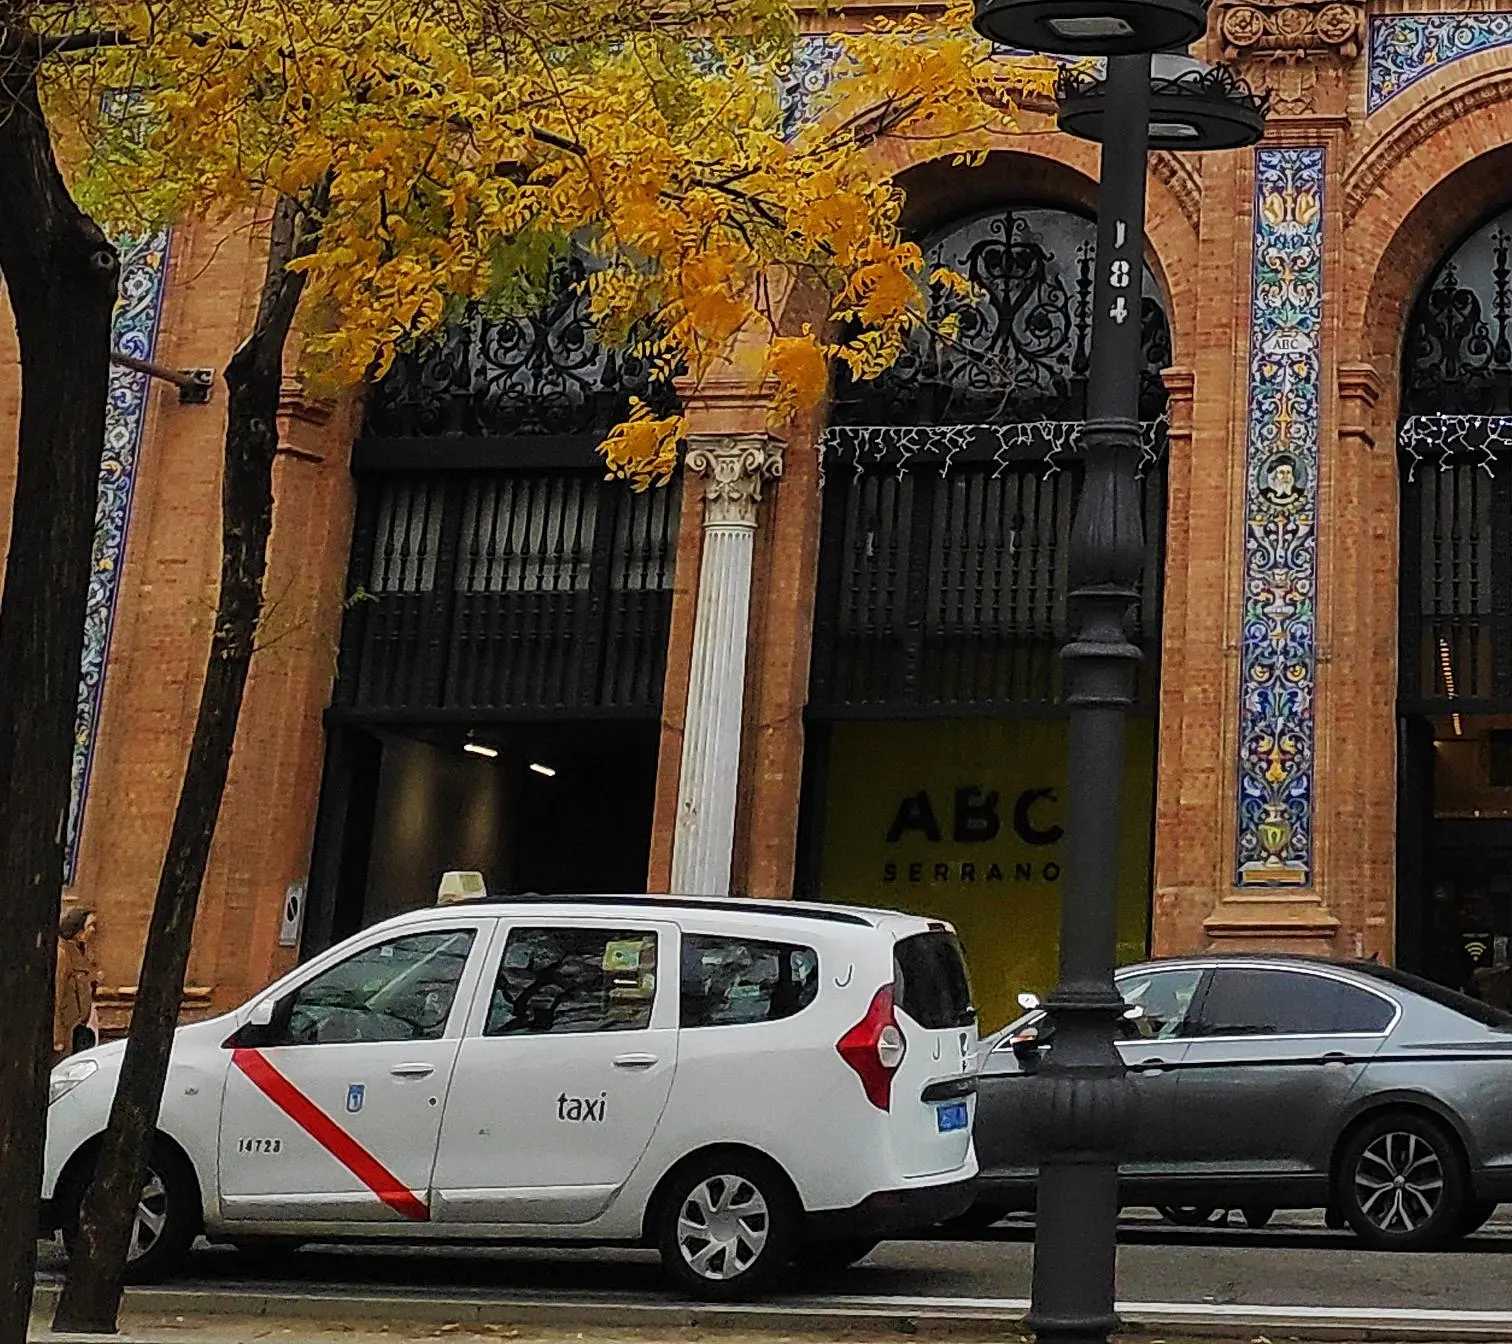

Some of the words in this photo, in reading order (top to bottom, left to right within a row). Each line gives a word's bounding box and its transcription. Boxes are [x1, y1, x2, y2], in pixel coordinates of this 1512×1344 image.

[1273, 339, 1299, 350] ABC
[886, 786, 1065, 845] ABC
[884, 862, 1061, 883] SERRANO
[557, 1092, 607, 1122] taxi
